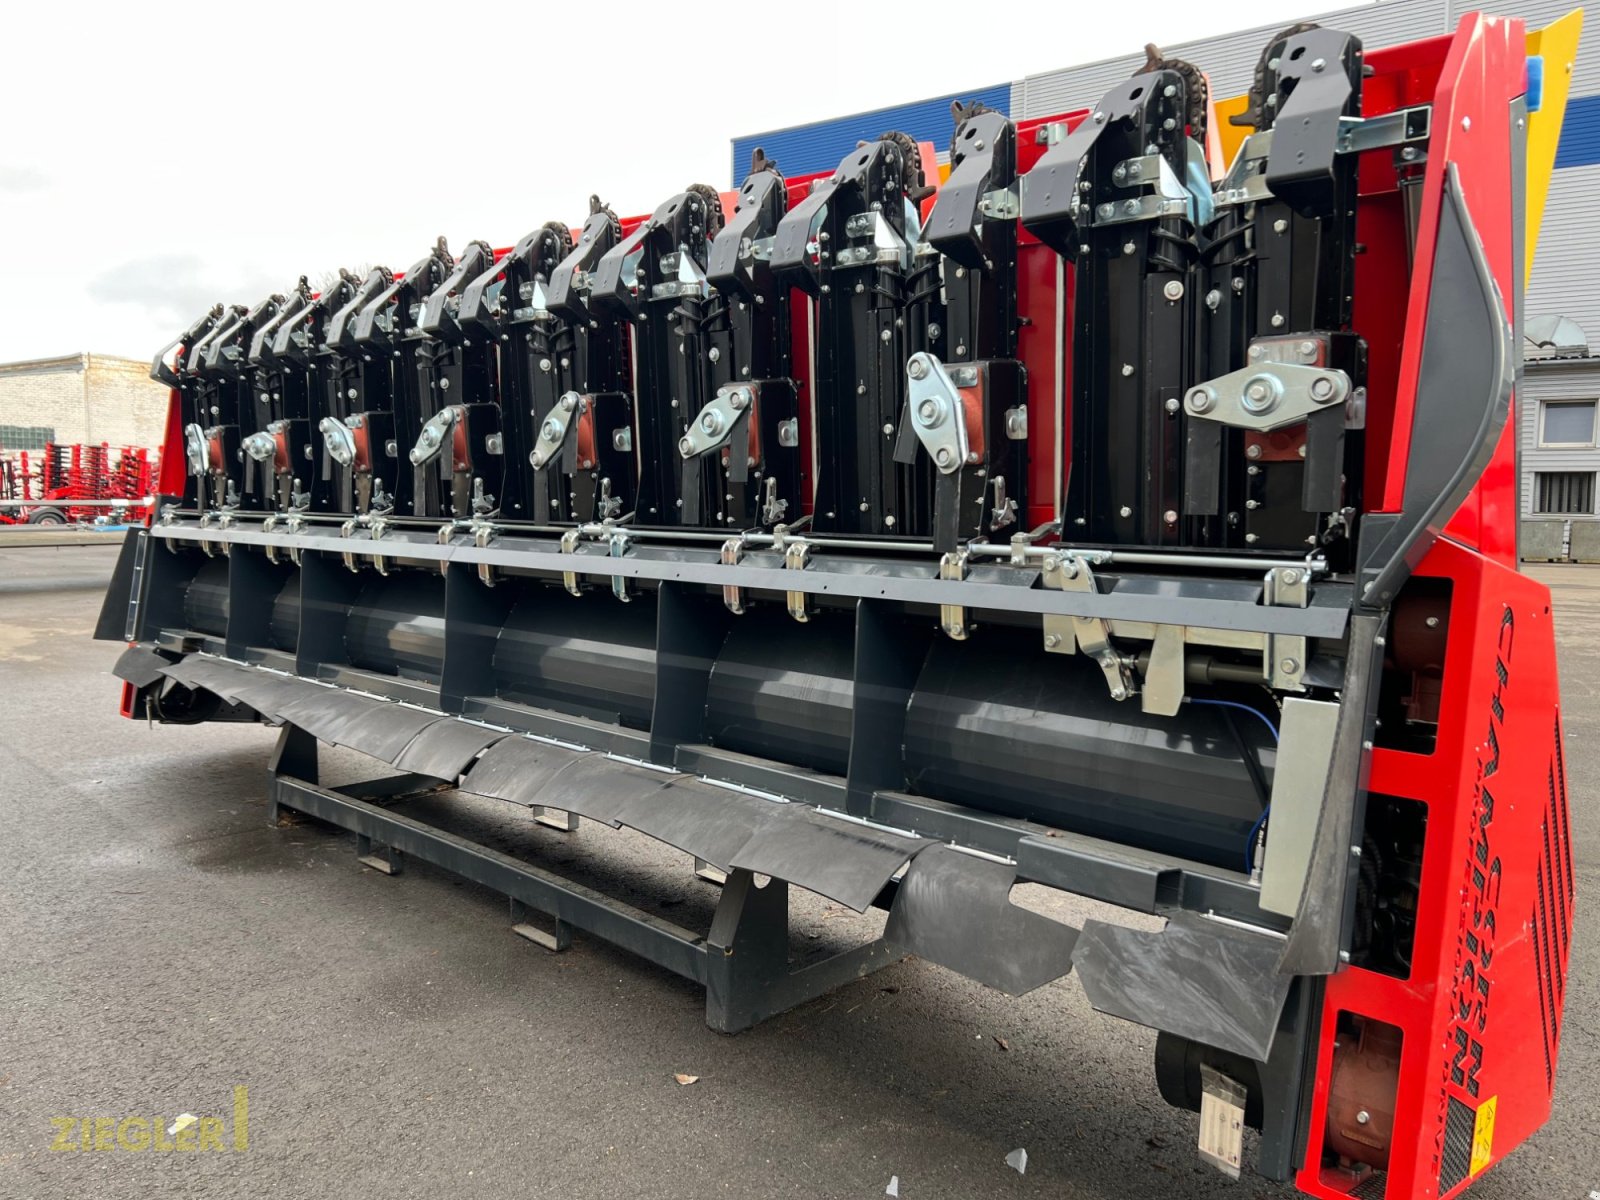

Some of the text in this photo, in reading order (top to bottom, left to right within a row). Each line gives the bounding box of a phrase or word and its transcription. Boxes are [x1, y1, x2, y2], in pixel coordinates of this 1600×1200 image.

[1430, 758, 1481, 1176] PROFESSIONAL DRIVE
[1451, 607, 1514, 1087] CHAMPION
[1467, 857, 1502, 1097] CORN
